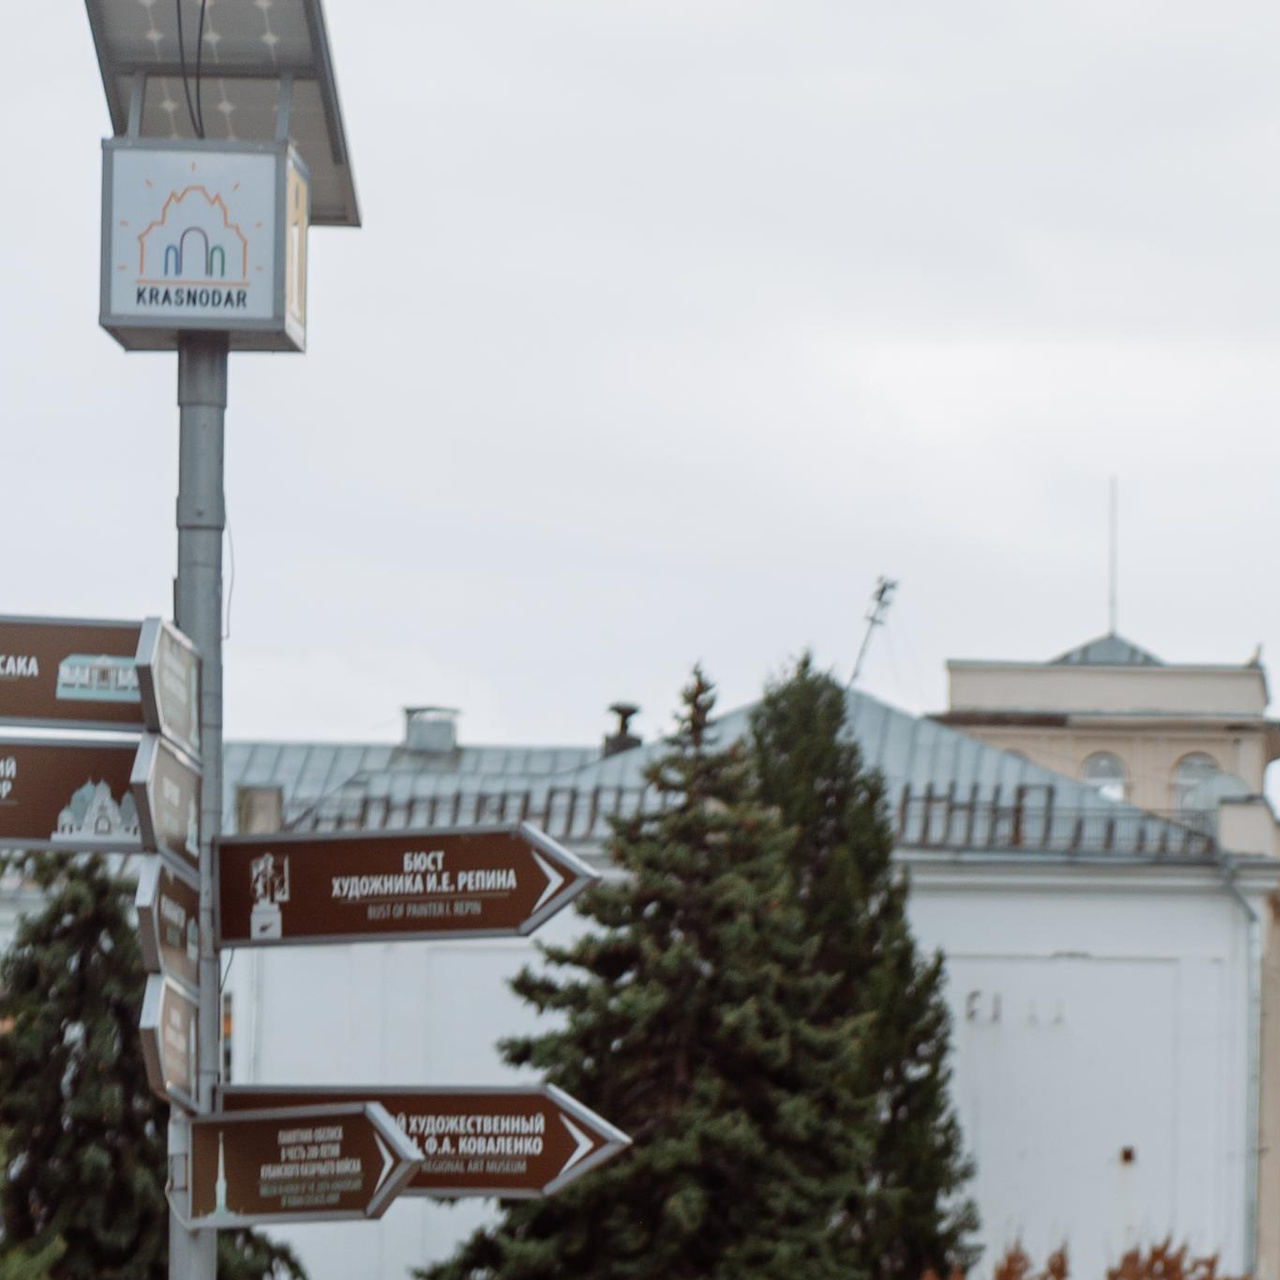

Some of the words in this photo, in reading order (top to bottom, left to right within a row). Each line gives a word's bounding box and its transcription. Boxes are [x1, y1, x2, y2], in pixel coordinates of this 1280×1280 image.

[136, 287, 248, 308] KRASNODAR
[403, 850, 445, 872] БЮСТ
[331, 874, 424, 900] ХУДОЖНИКА
[425, 872, 455, 893] И.Е.
[457, 869, 517, 892] РЕПИНА
[408, 1112, 545, 1135] ХУДОЖЕСТВЕННЫЙ
[425, 1134, 456, 1155] Ф.А.
[458, 1136, 543, 1156] КОВАЛЕНКО
[467, 1159, 484, 1172] ART
